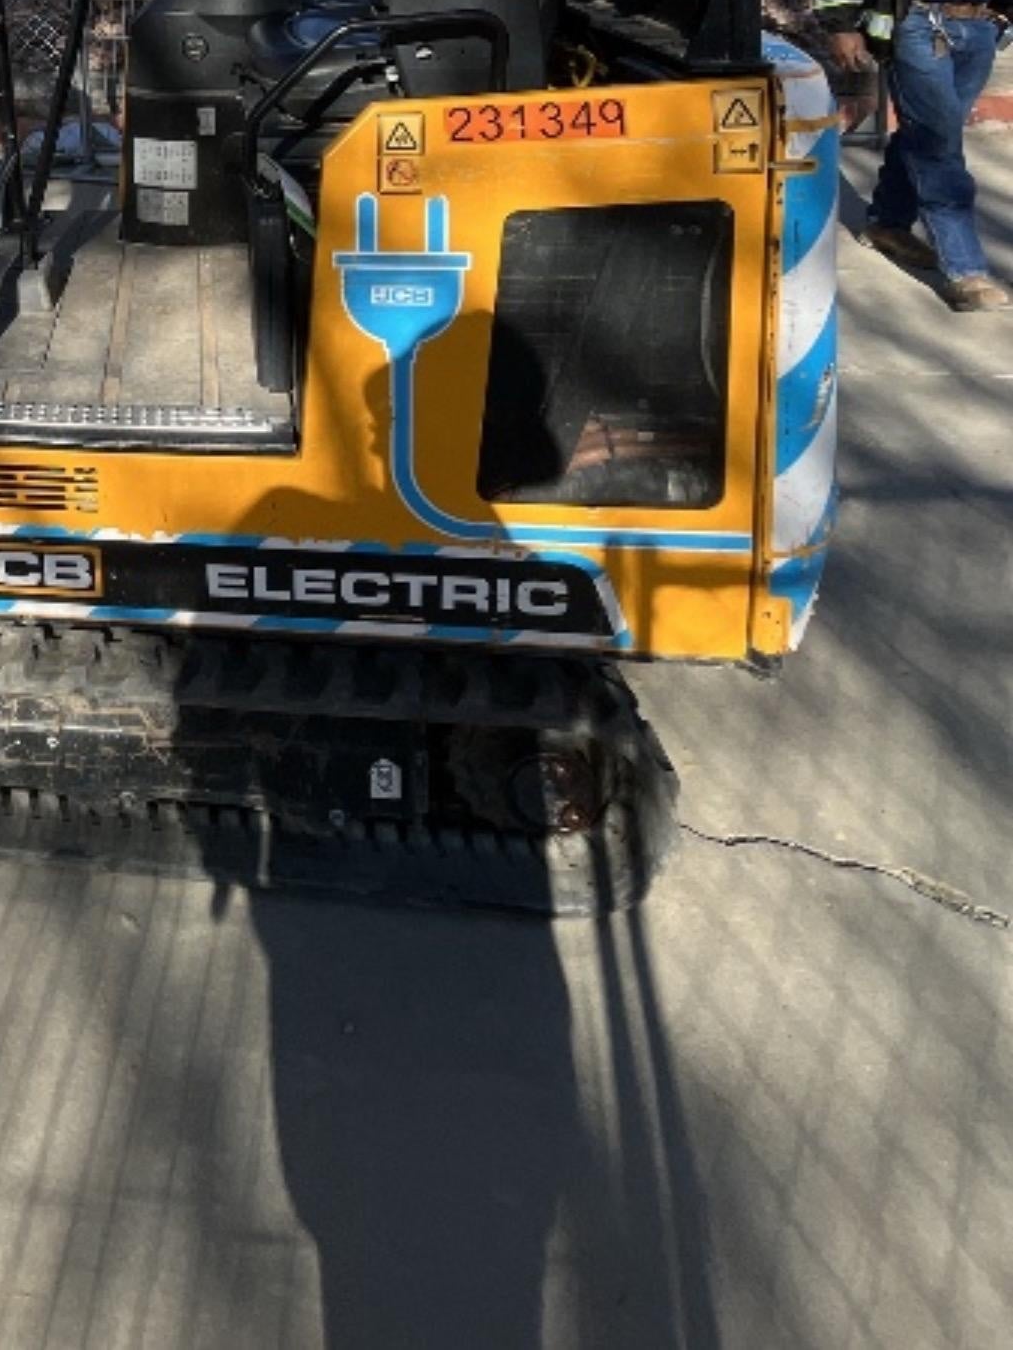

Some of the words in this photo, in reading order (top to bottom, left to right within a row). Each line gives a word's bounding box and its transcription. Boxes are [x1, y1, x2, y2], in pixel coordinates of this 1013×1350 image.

[448, 99, 625, 142] 231349
[373, 286, 430, 304] JCB
[205, 563, 568, 616] ELECTRIC
